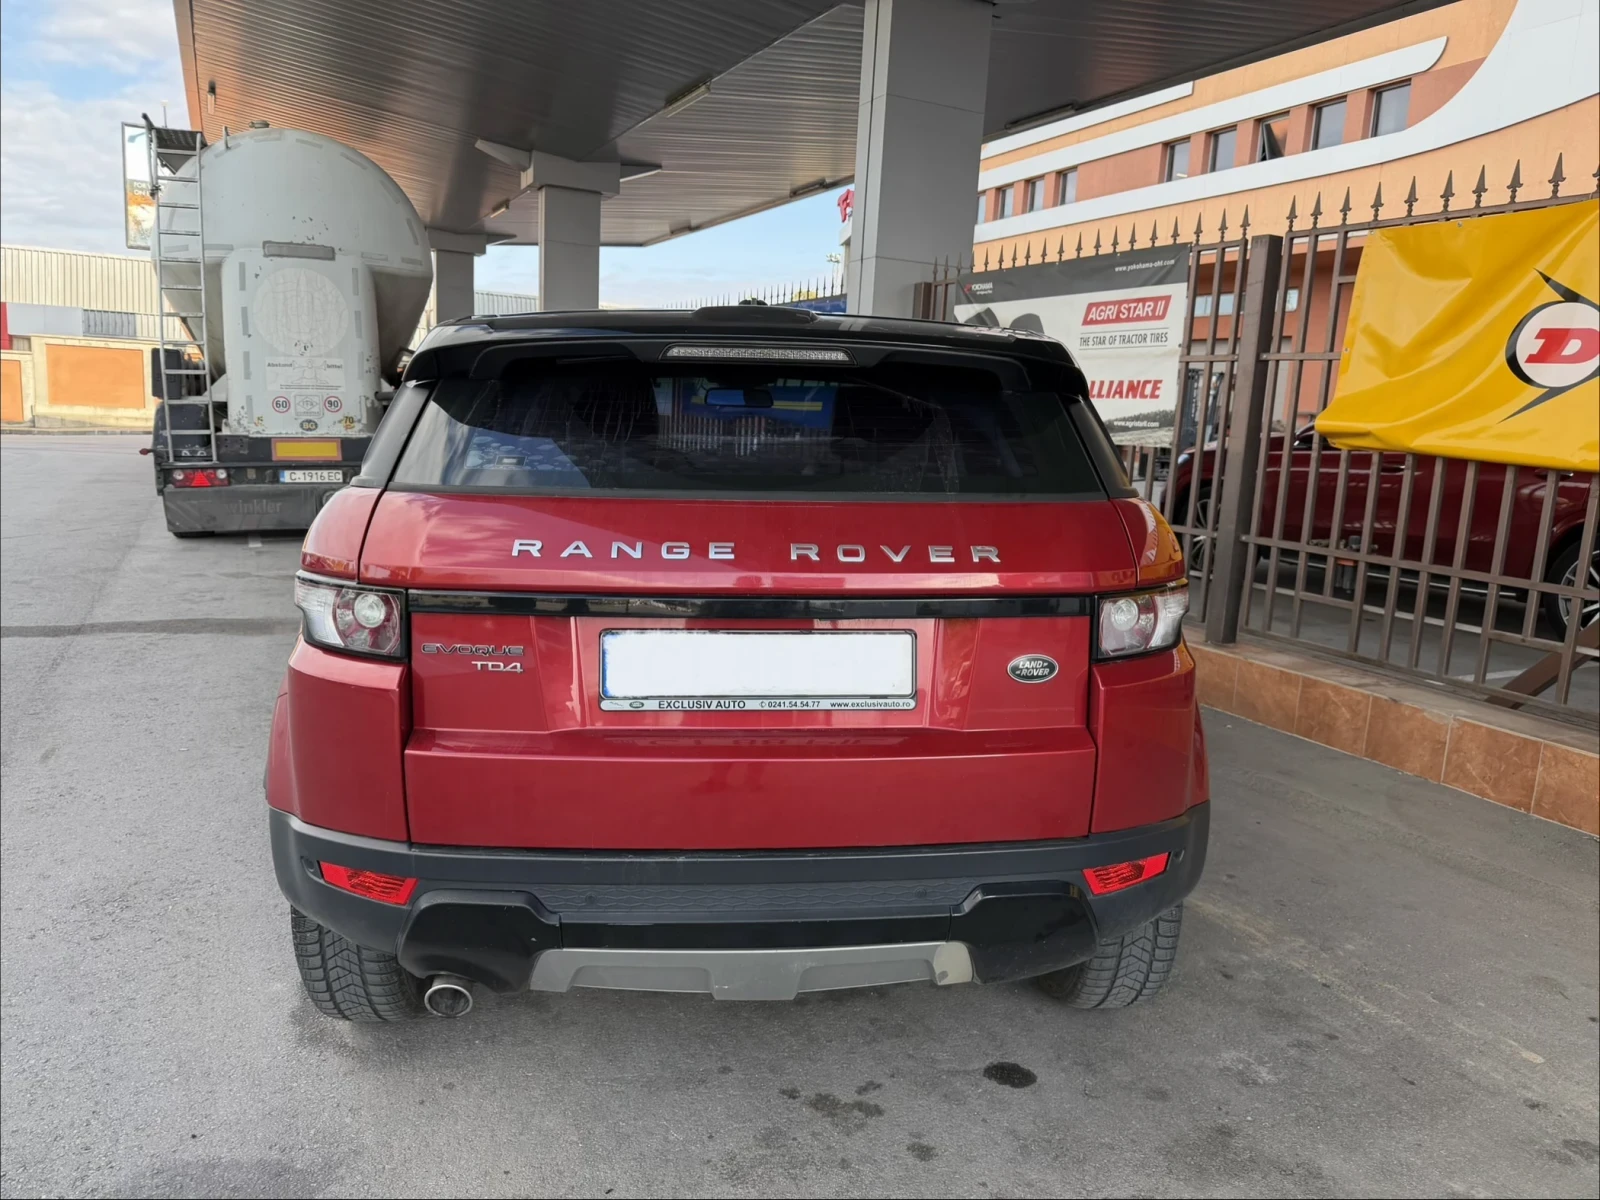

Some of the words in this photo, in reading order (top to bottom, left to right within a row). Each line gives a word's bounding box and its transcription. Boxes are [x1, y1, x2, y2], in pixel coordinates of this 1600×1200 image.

[1114, 259, 1175, 272] www.yokohama-oht.com
[1087, 304, 1119, 322] AGRI
[1119, 301, 1154, 319] STAR
[1079, 336, 1091, 347] THE
[1092, 335, 1107, 347] STAR
[1108, 334, 1117, 346] OF
[1118, 333, 1148, 346] TRACTOR
[1149, 332, 1169, 344] TIRES
[1088, 379, 1163, 400] LLIANCE
[275, 400, 288, 409] 60
[327, 399, 339, 408] 90
[302, 421, 317, 430] BG
[511, 538, 736, 561] RANGE
[790, 542, 1001, 563] ROVER
[421, 643, 524, 657] EVOQUE
[471, 661, 524, 674] TD4
[1019, 660, 1043, 669] LAND
[1020, 668, 1050, 677] ROVER
[658, 700, 713, 709] EXCLUSIV
[715, 700, 746, 709] AUTO
[767, 700, 821, 709] 0241.54.54.77
[830, 700, 911, 709] www.exclusivauto.ro
